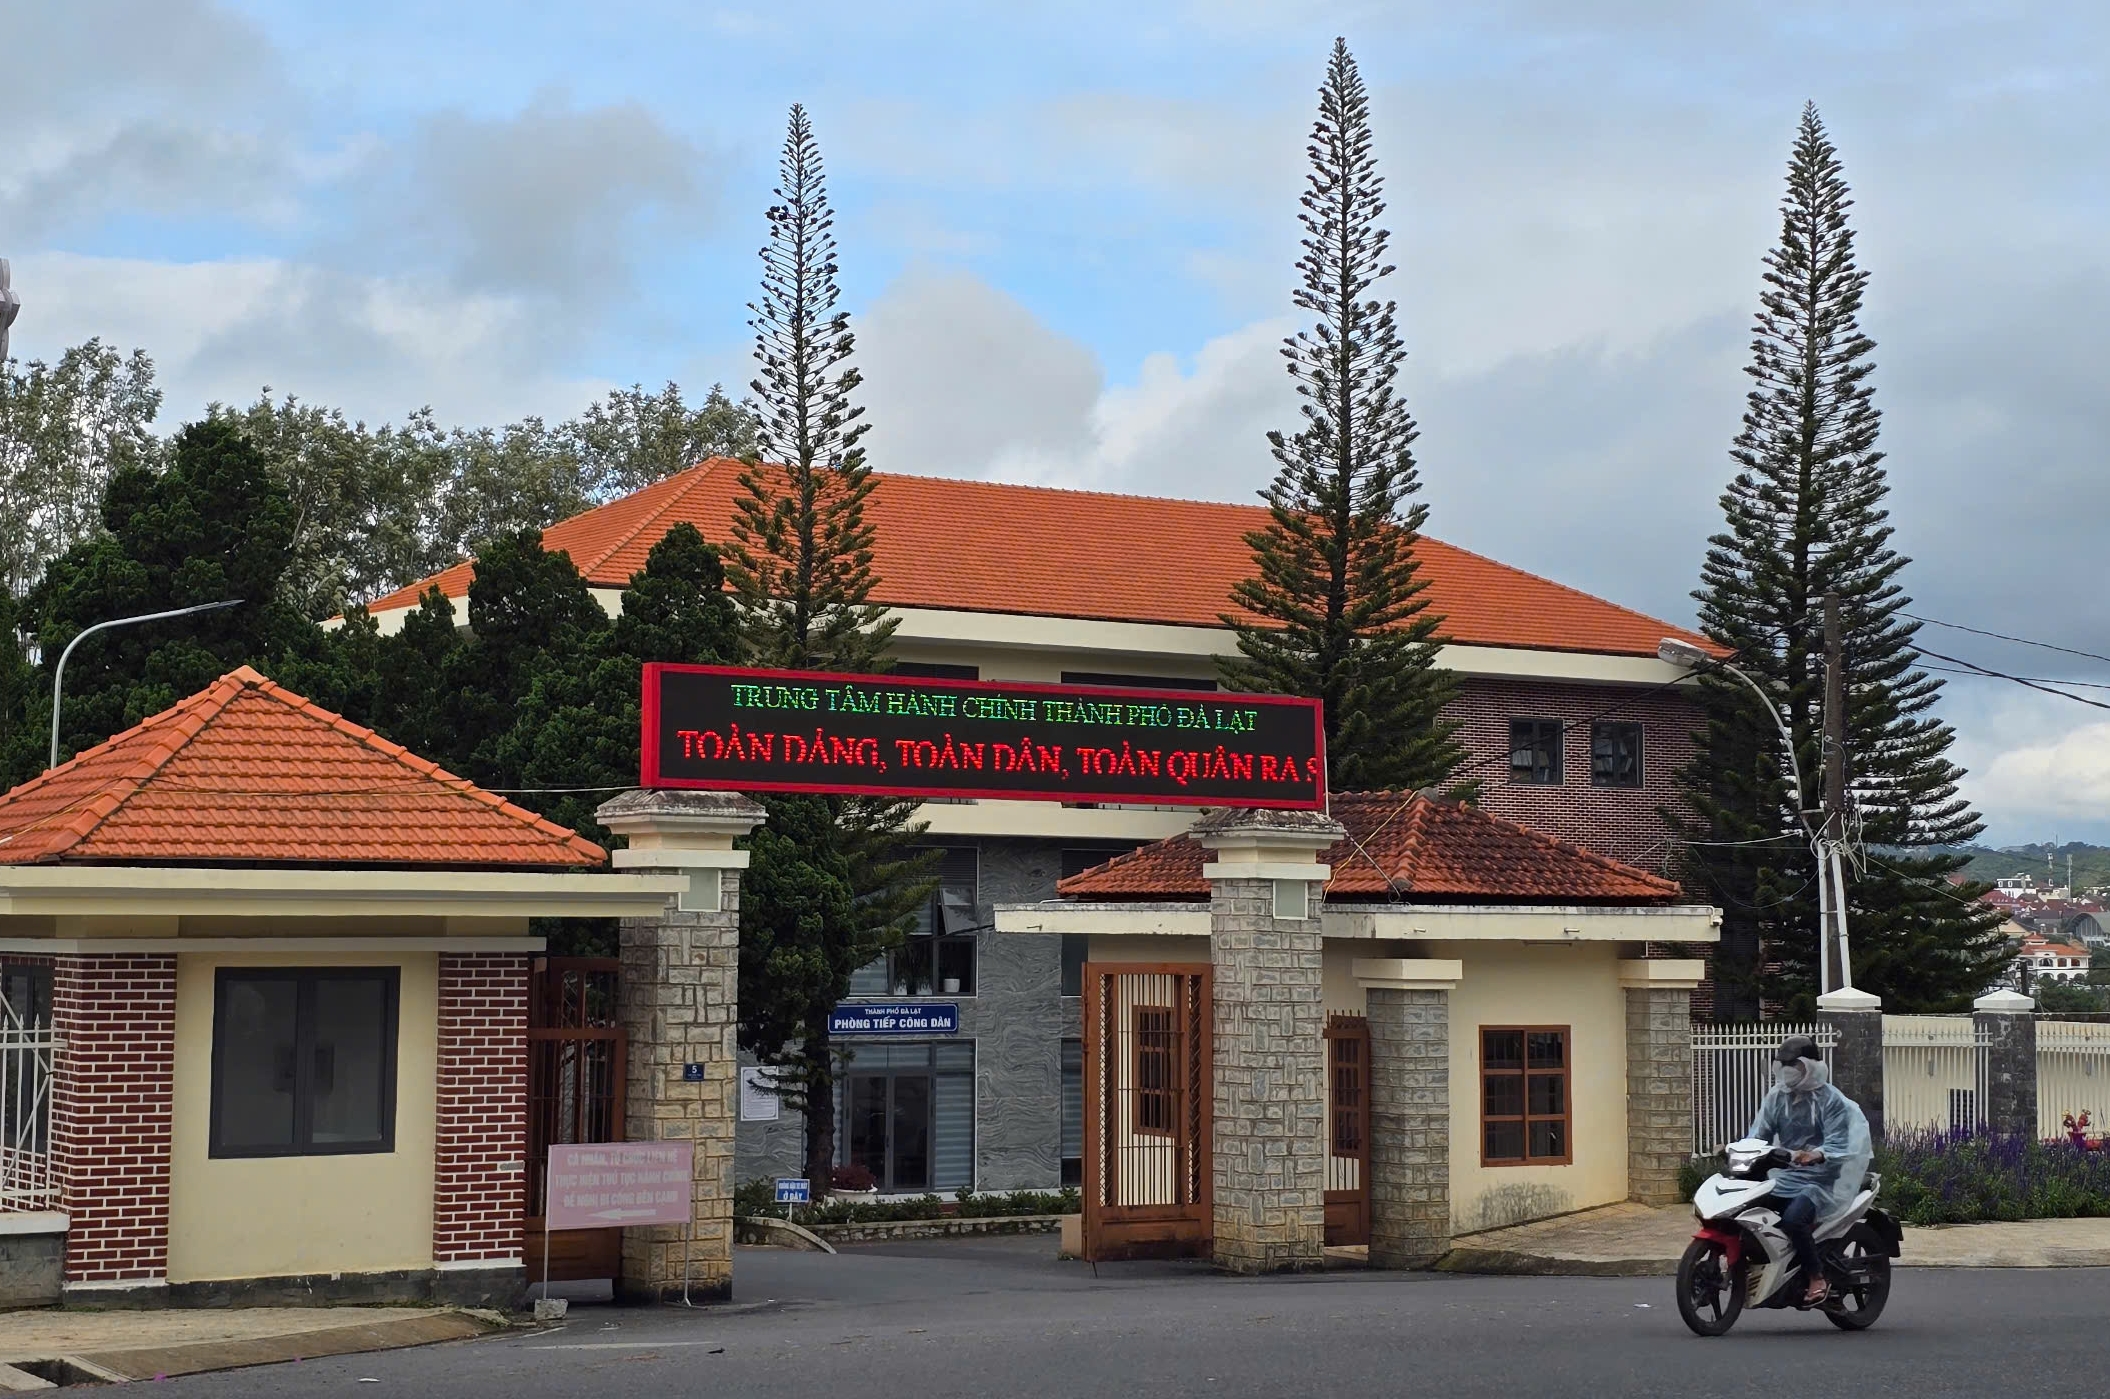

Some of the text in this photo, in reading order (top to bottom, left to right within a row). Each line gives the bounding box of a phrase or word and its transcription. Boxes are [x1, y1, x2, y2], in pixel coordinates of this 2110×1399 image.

[731, 684, 819, 709] TRUNG
[825, 684, 881, 713] TÂM
[886, 689, 957, 717] HÀNH
[963, 693, 1037, 721] CHÍNH
[1215, 709, 1258, 734] LẠT
[1166, 744, 1255, 786] QUÂN
[1260, 755, 1301, 782] RA
[865, 1007, 885, 1015] THÀNH
[834, 1015, 951, 1029] PHÒNG TIẾP CÔNG DÂN
[692, 1065, 698, 1074] 5
